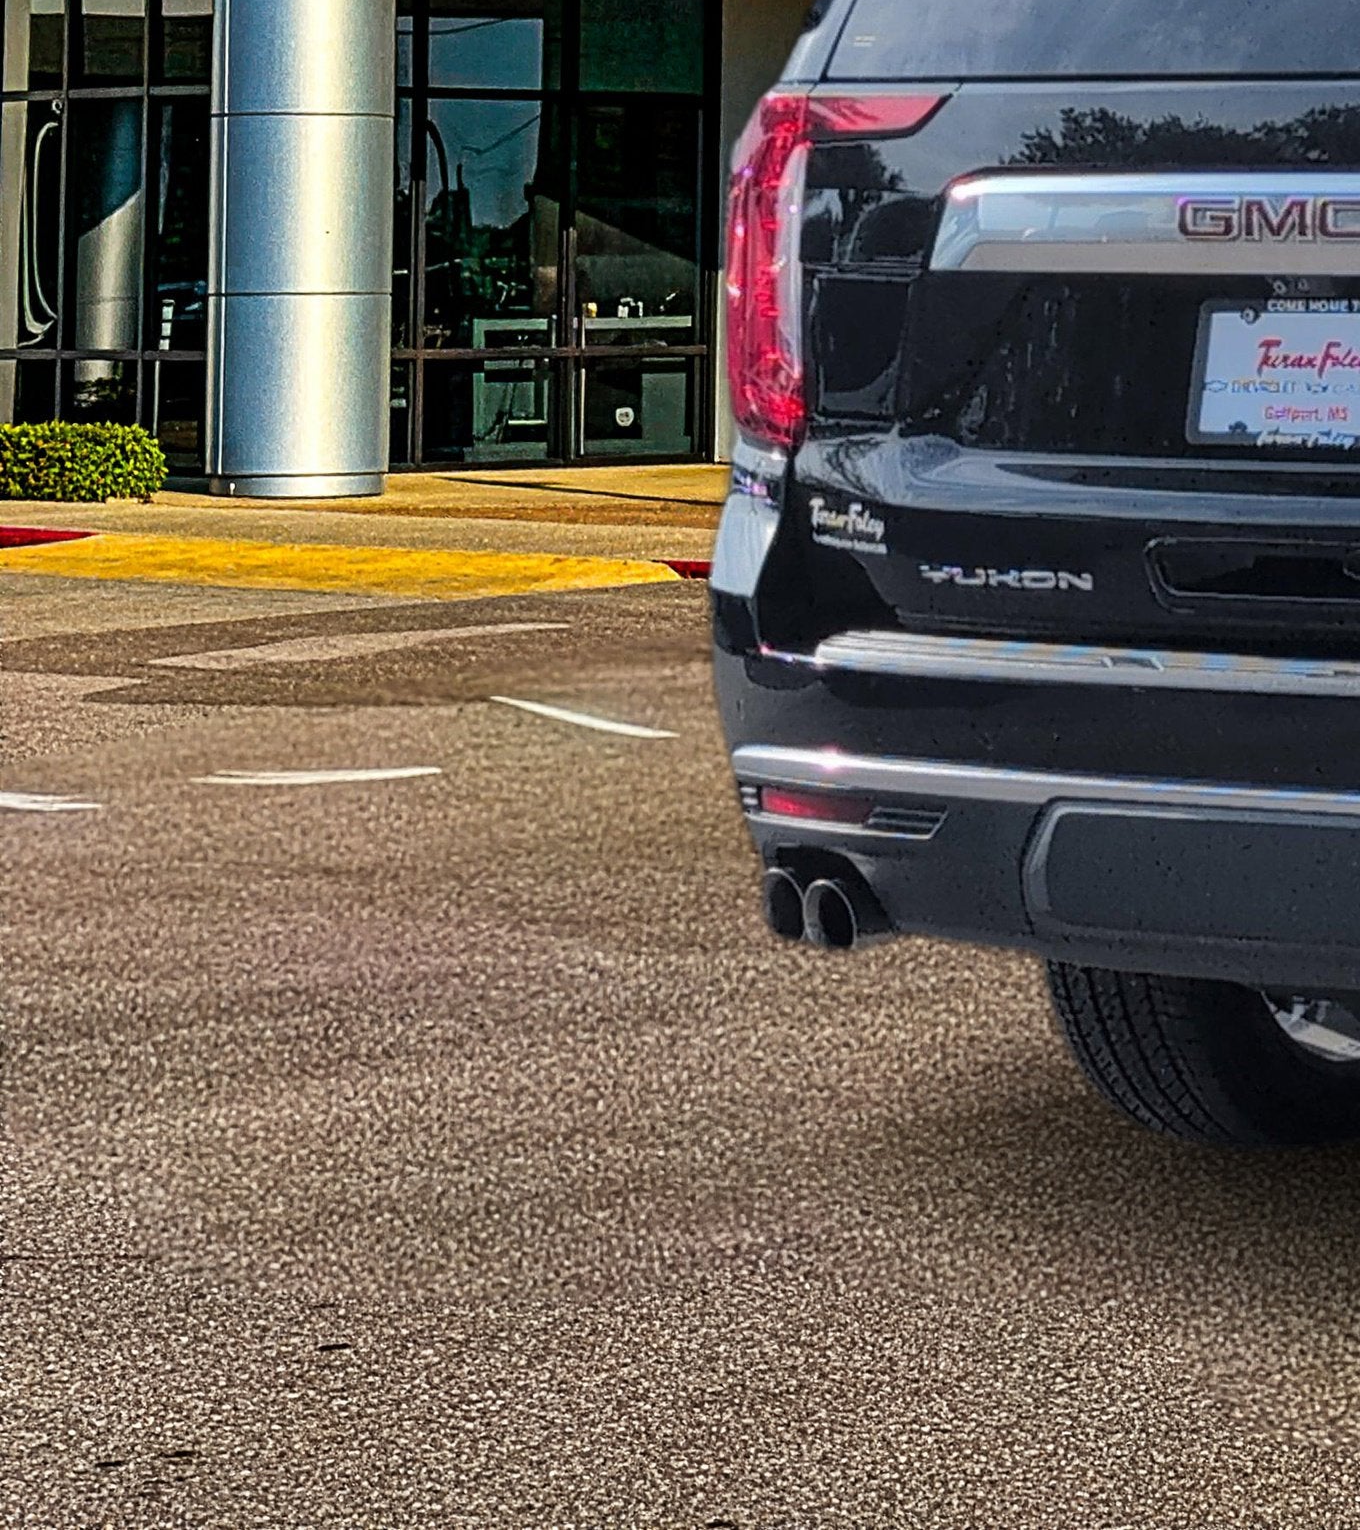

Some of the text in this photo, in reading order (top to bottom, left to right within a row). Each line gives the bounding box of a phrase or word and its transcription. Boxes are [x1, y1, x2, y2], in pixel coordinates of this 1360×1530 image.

[1256, 338, 1317, 378] Turan
[1327, 406, 1349, 422] MS
[919, 564, 1093, 591] YUKON
